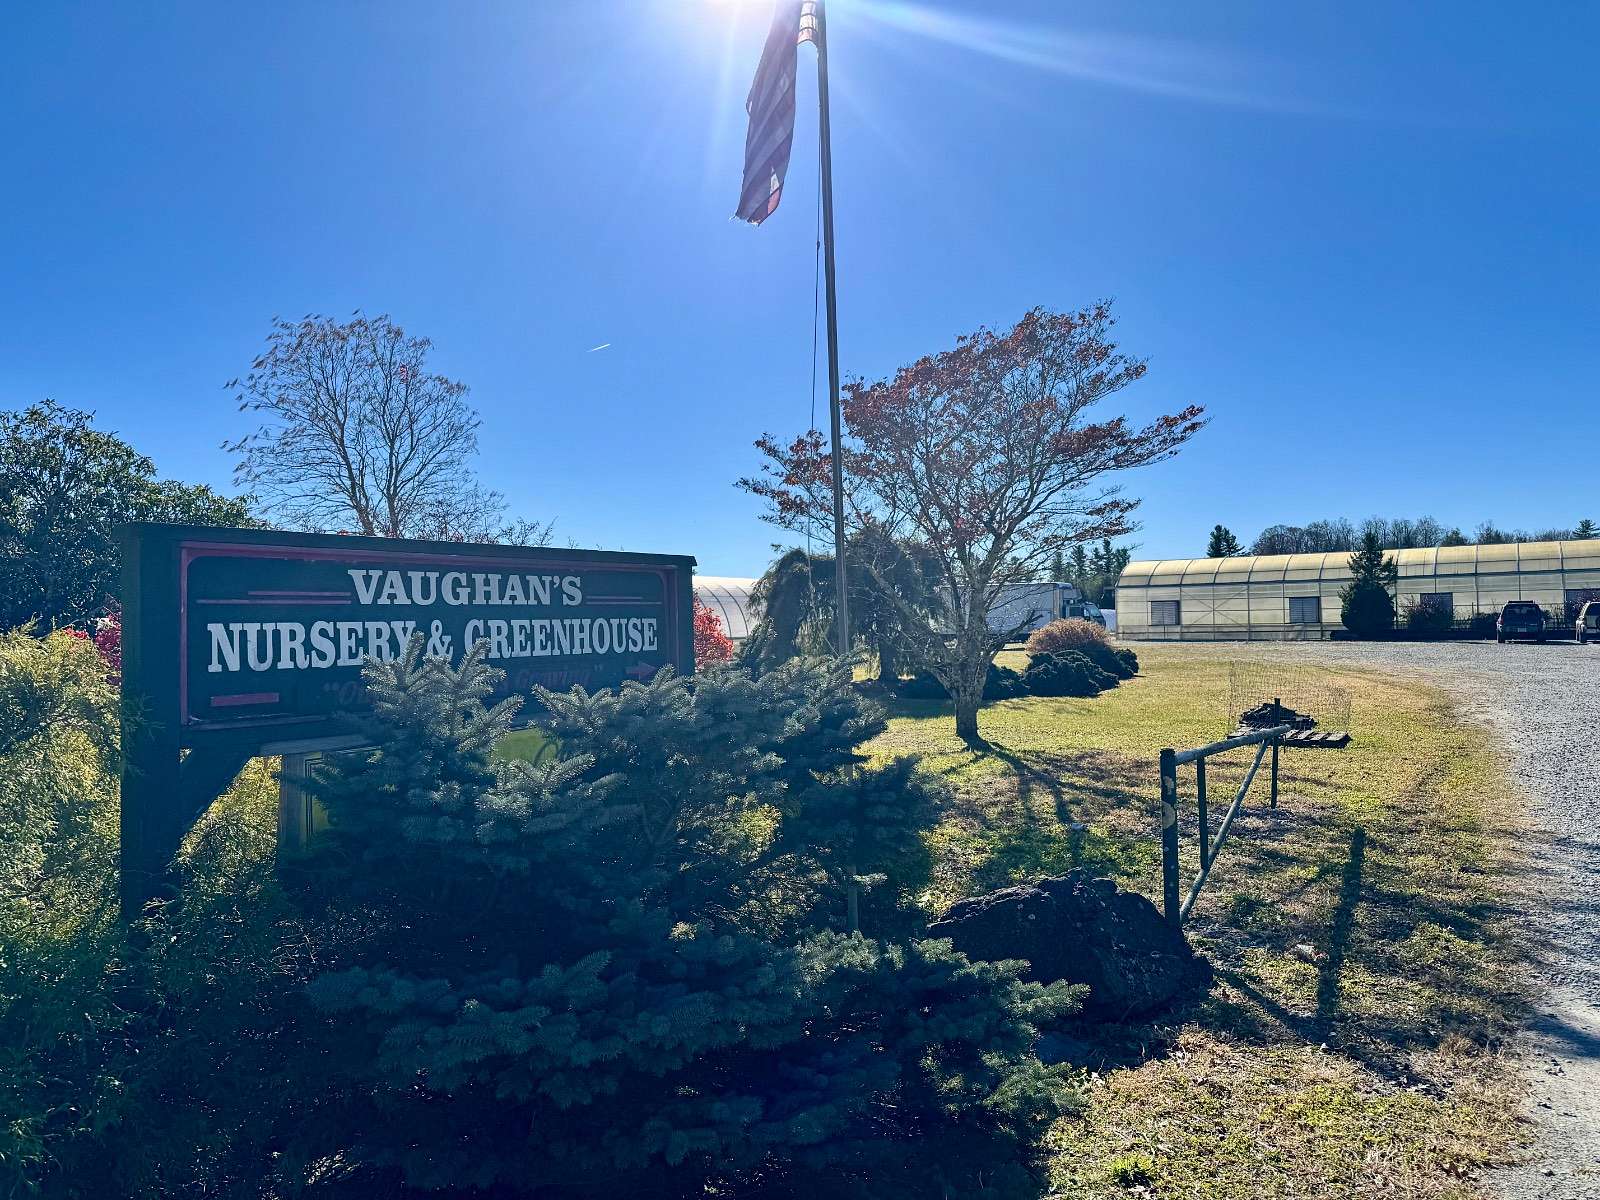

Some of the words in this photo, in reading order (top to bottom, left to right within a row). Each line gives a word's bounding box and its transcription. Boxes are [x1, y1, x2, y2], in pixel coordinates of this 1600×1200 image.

[348, 569, 583, 607] VAUGHAN'S
[207, 620, 417, 674] NURSERY
[427, 619, 455, 661] &
[464, 617, 659, 662] GREENHOUSE
